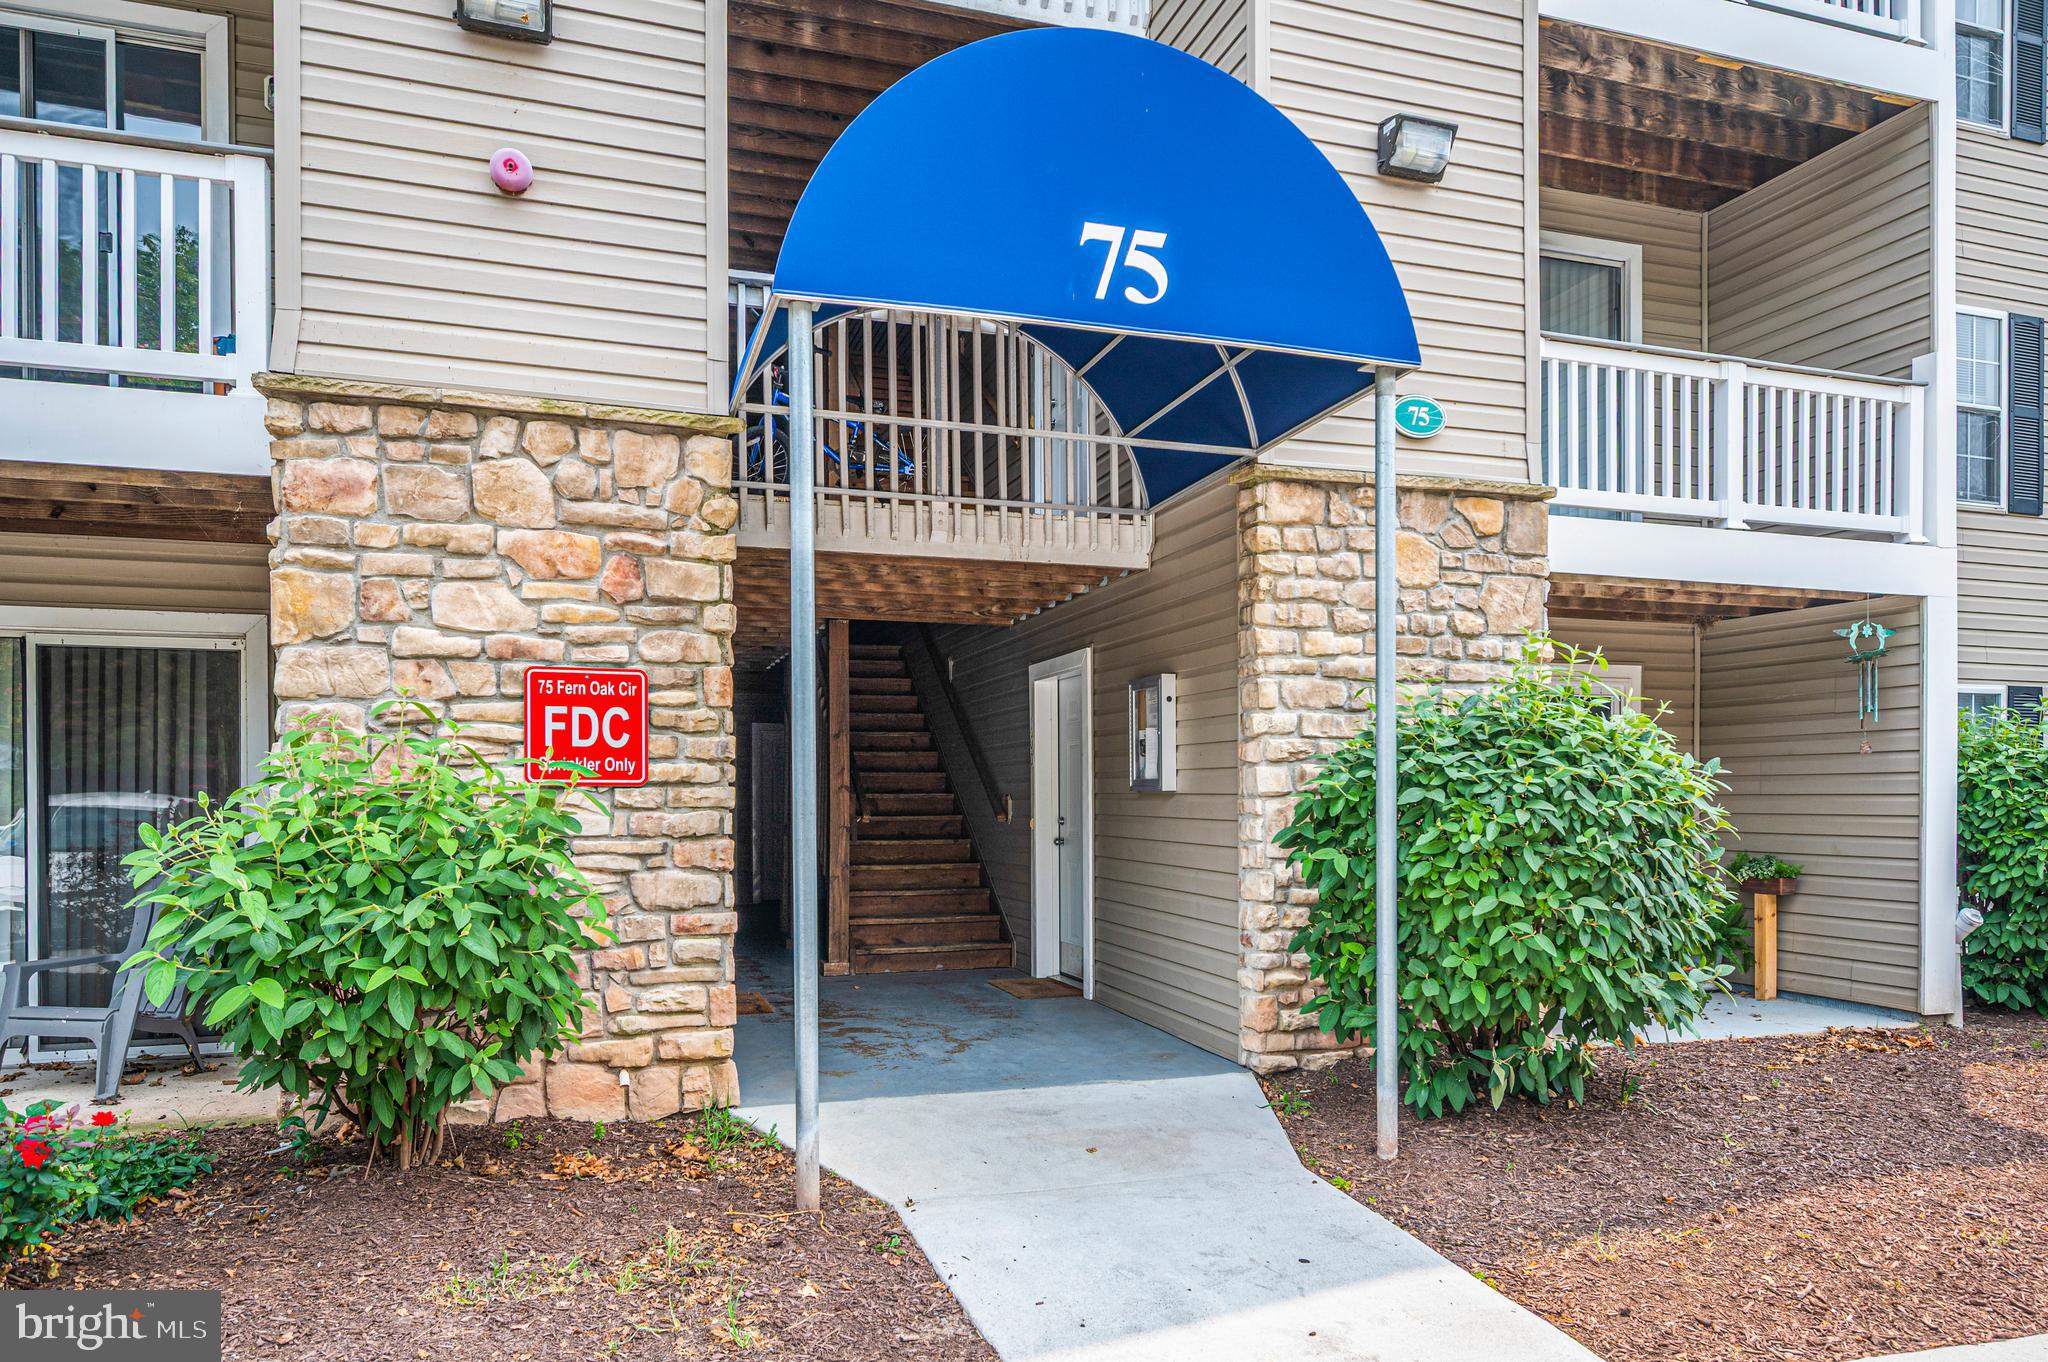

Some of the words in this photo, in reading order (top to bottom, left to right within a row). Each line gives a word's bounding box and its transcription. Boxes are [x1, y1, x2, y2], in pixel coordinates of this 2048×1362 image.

[1079, 221, 1169, 305] 75
[1407, 405, 1431, 427] 75
[537, 679, 554, 695] 75
[557, 680, 587, 695] Fern
[589, 681, 615, 696] Oak
[618, 682, 638, 696] Cir
[544, 705, 630, 748] FDC
[604, 757, 636, 775] Only
